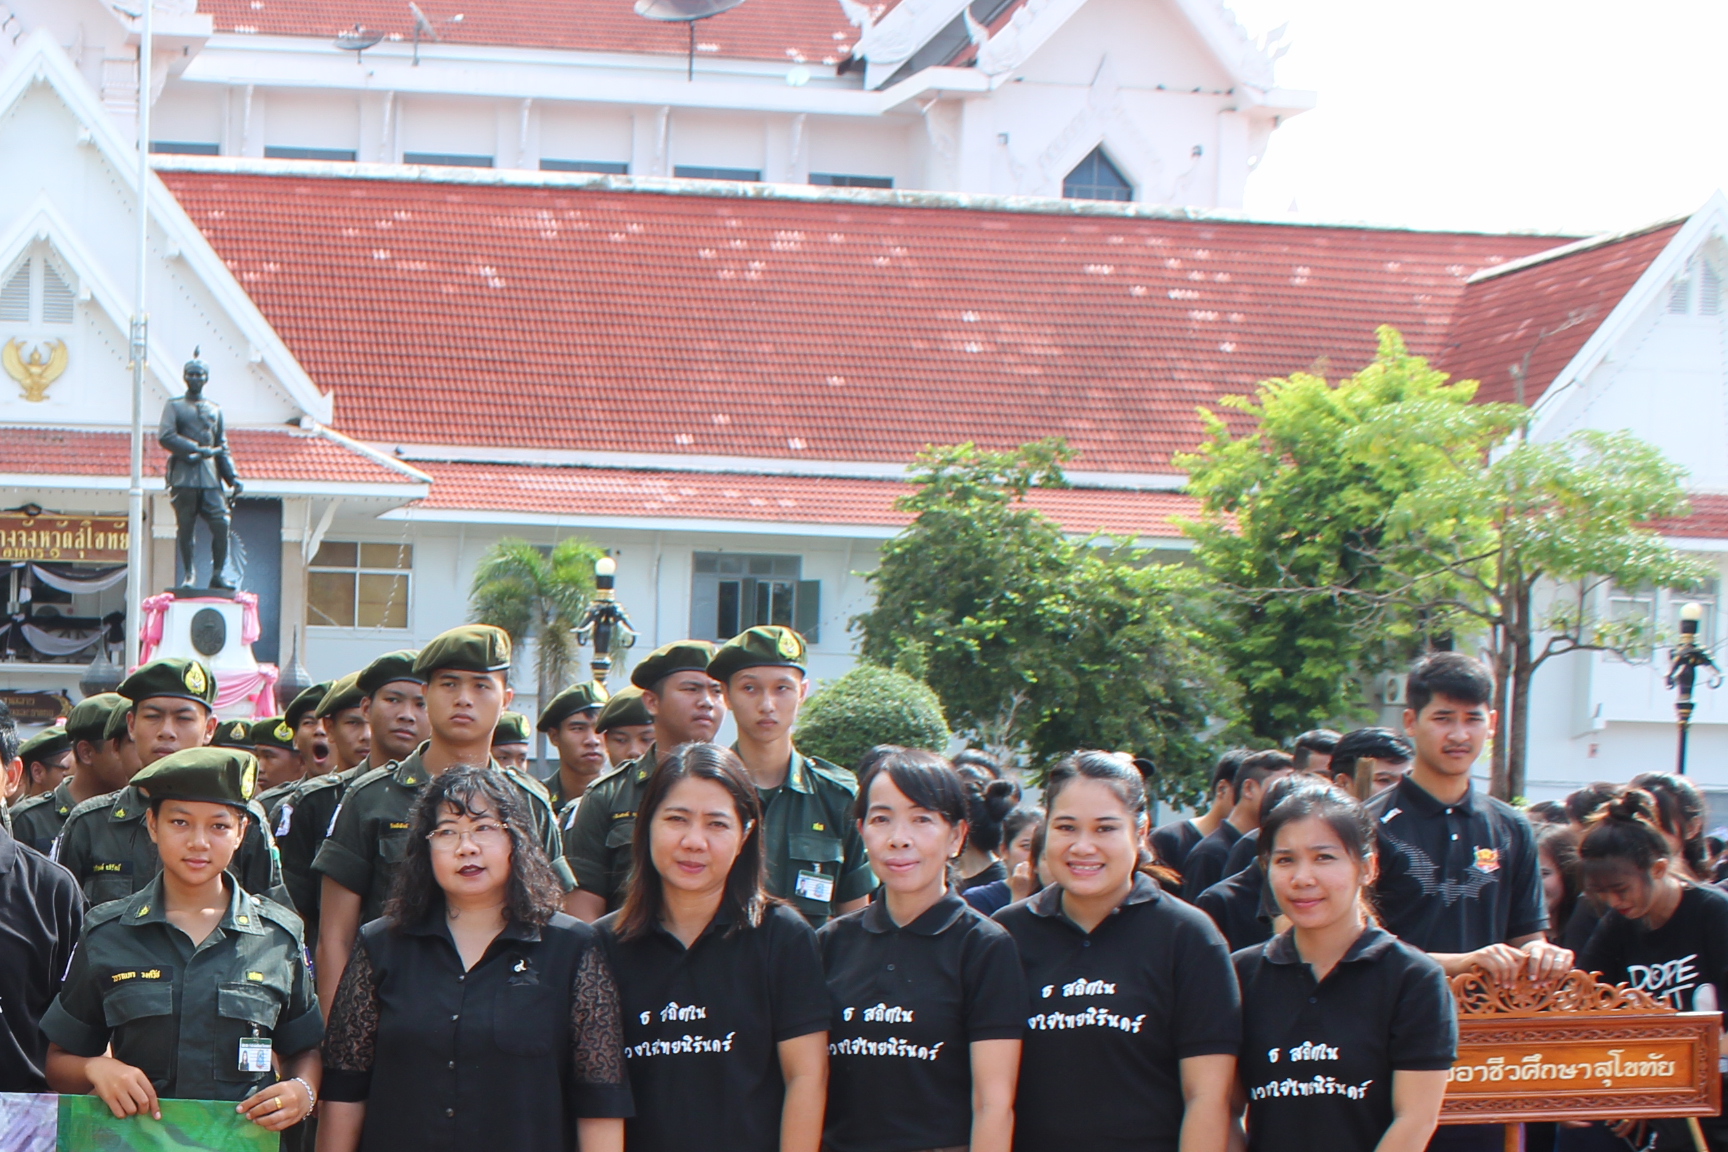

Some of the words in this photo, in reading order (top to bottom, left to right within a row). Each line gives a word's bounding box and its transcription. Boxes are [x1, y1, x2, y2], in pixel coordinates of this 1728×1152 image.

[1626, 953, 1699, 990] DOPE
[1040, 984, 1054, 999] ธ
[639, 1010, 651, 1026] ธ
[843, 1006, 855, 1022] ธ
[1268, 1047, 1281, 1063] ธ
